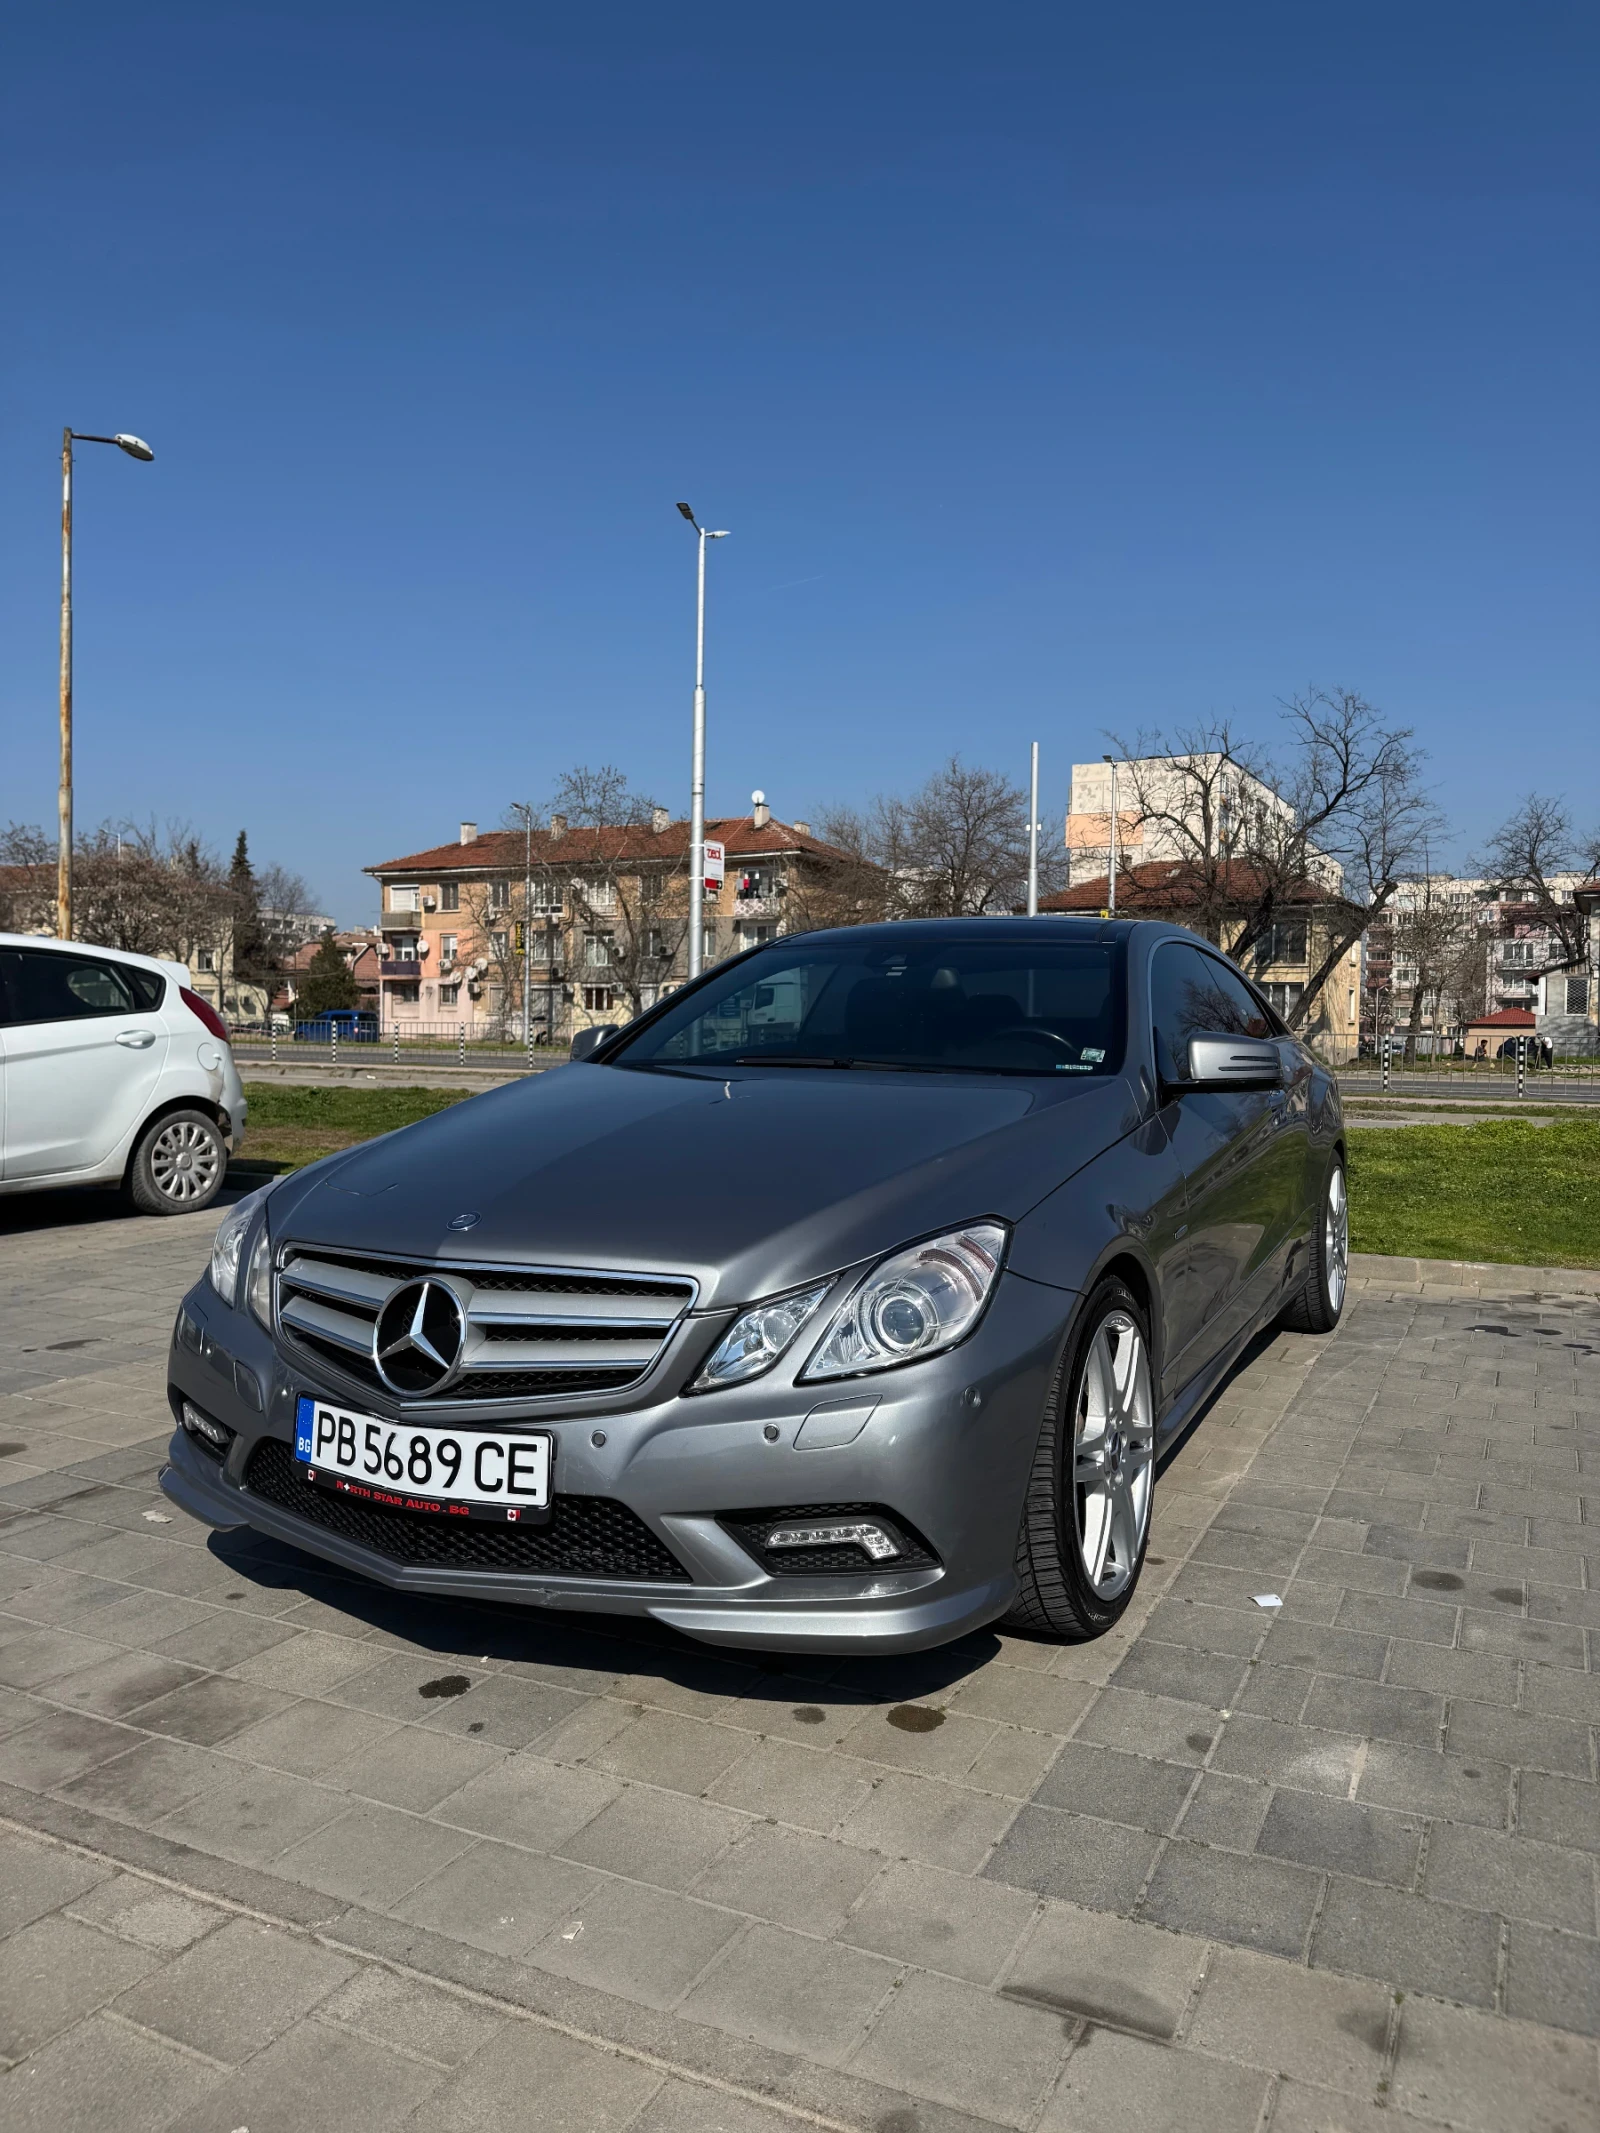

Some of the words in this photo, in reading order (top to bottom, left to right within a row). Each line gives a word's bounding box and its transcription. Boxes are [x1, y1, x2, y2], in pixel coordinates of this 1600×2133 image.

[298, 1436, 311, 1453] BG
[317, 1411, 356, 1466] PB
[364, 1424, 461, 1488] 5689
[475, 1442, 537, 1496] CE
[373, 1491, 403, 1506] STAR
